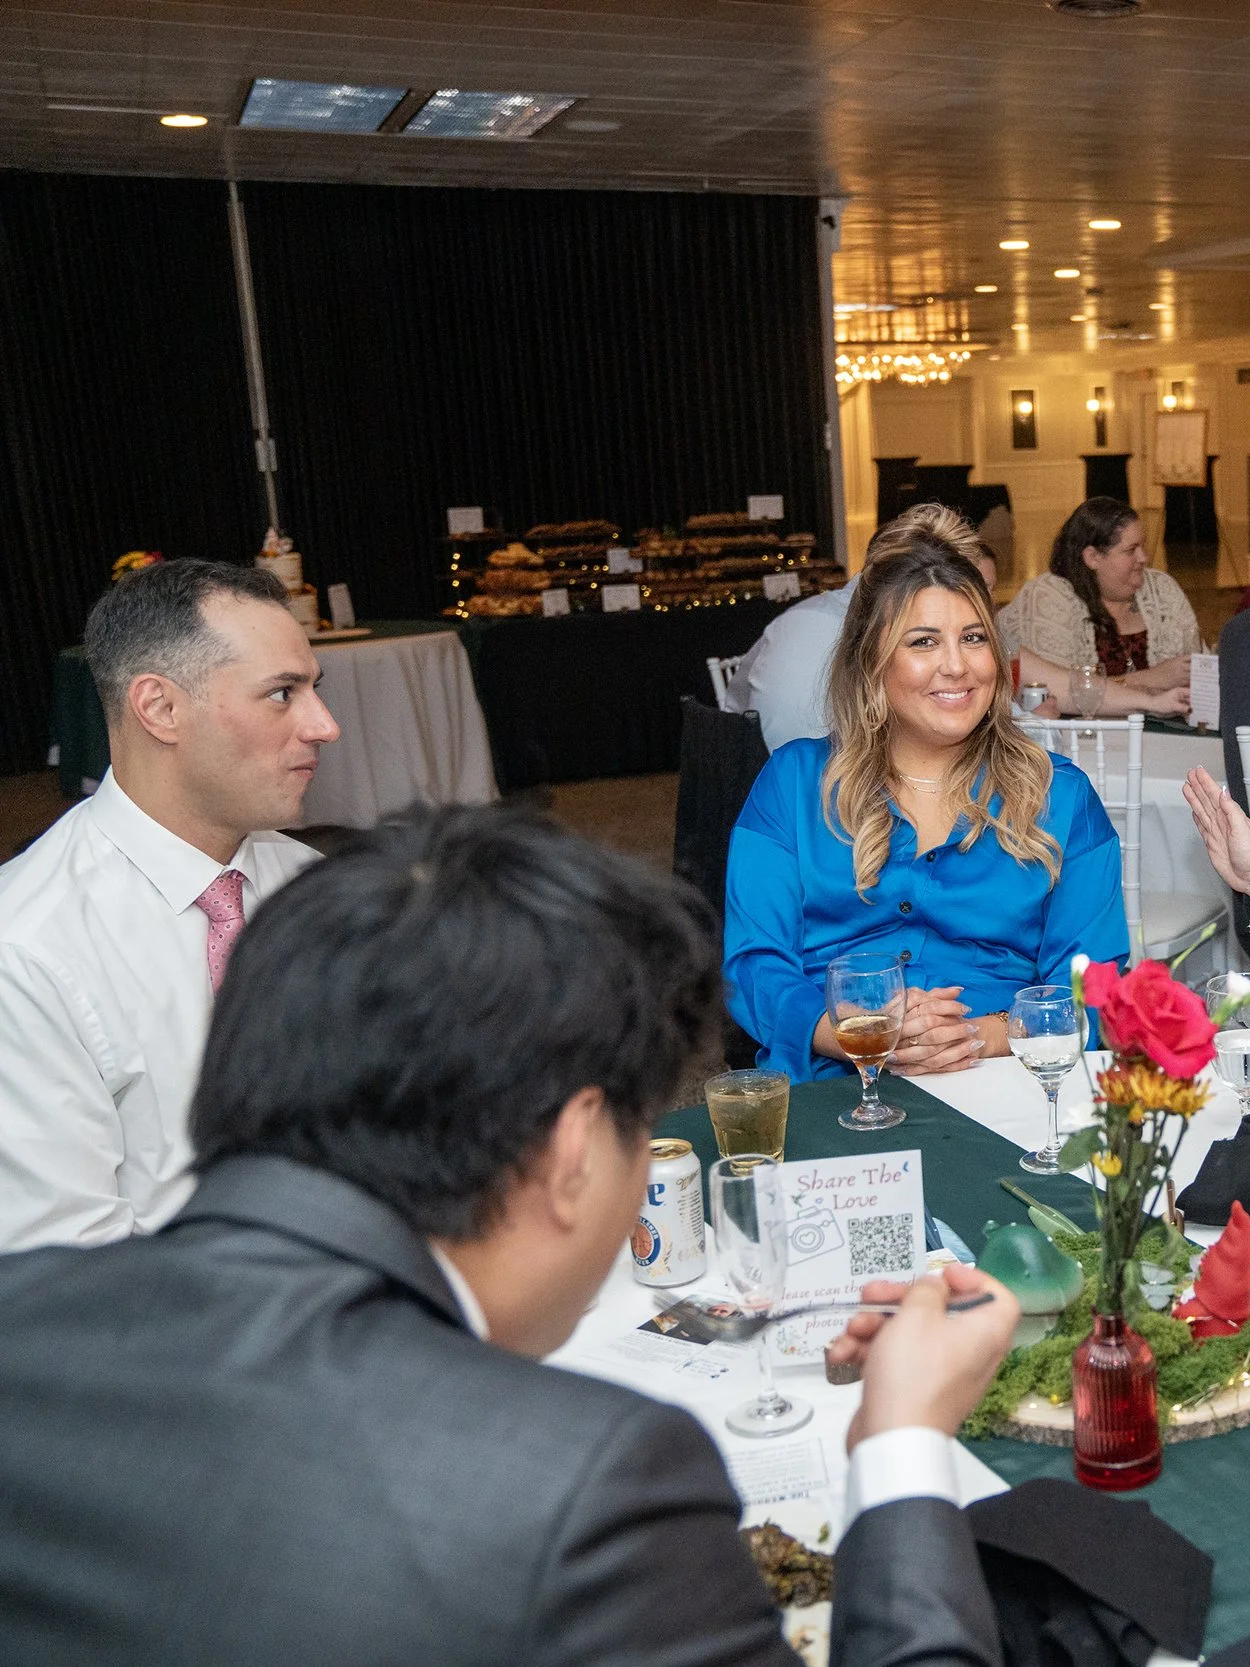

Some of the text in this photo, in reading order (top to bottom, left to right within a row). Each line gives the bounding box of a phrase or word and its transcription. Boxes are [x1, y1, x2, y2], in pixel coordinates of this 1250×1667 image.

[797, 1162, 902, 1193] Share The
[832, 1193, 879, 1211] Love
[781, 1286, 811, 1301] lease
[814, 1286, 841, 1297] scan
[803, 1315, 844, 1334] photos
